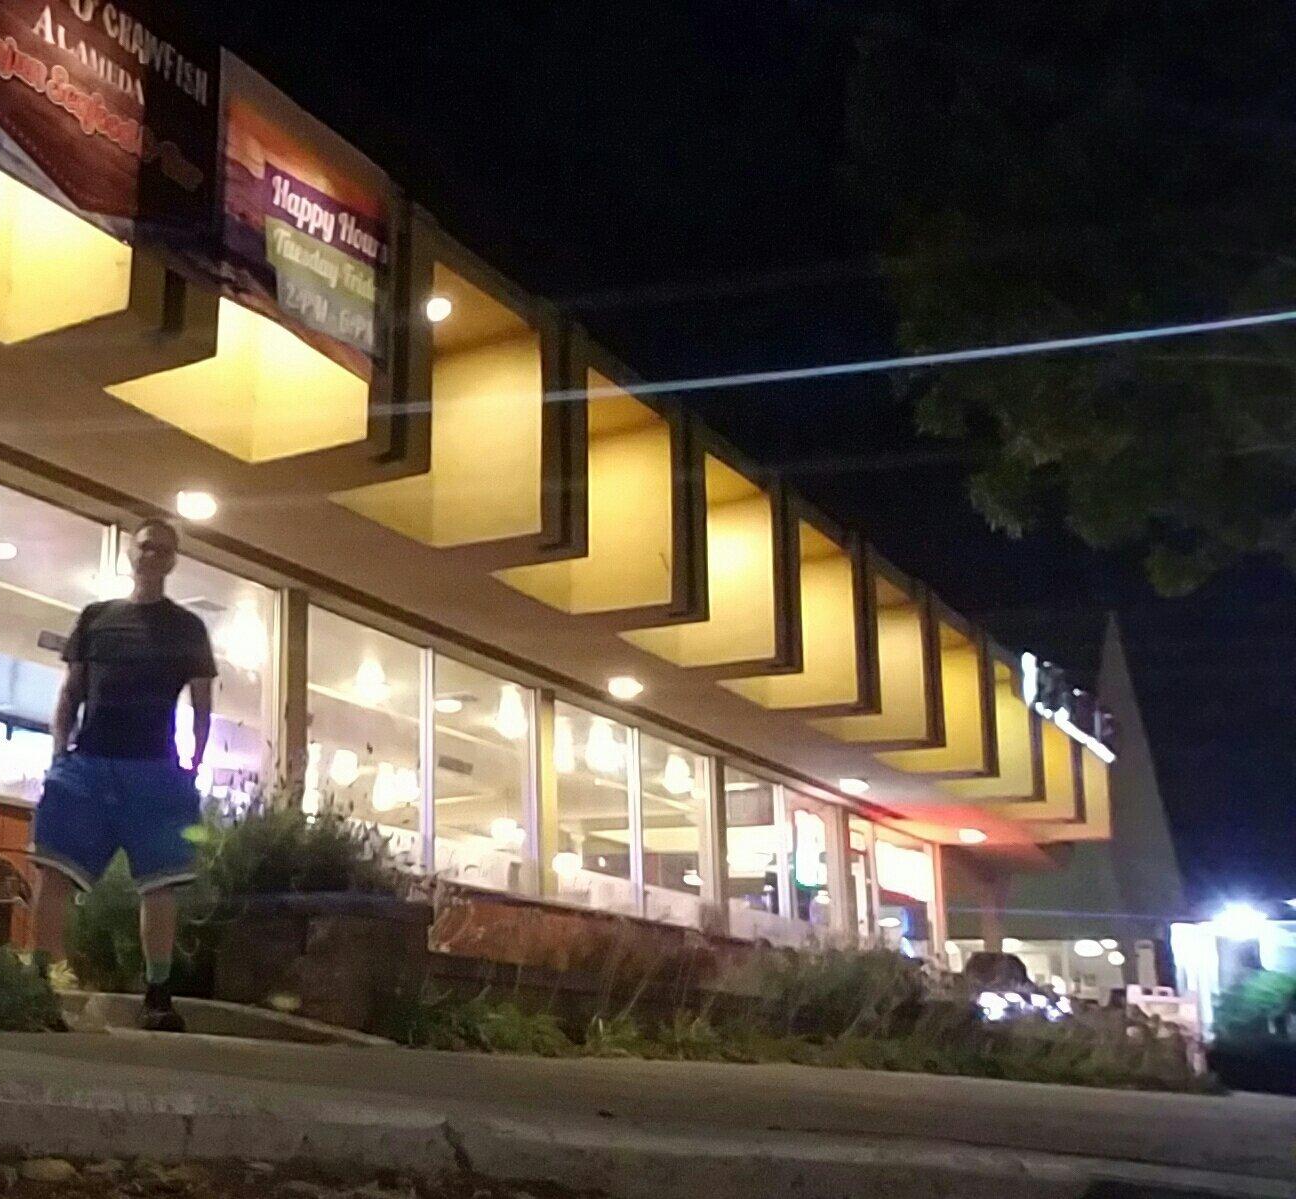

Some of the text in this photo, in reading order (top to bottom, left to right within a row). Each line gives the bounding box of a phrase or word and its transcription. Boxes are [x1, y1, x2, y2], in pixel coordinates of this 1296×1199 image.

[46, 65, 140, 154] Seafood
[272, 176, 335, 243] Happy
[273, 228, 339, 289] Tuesday
